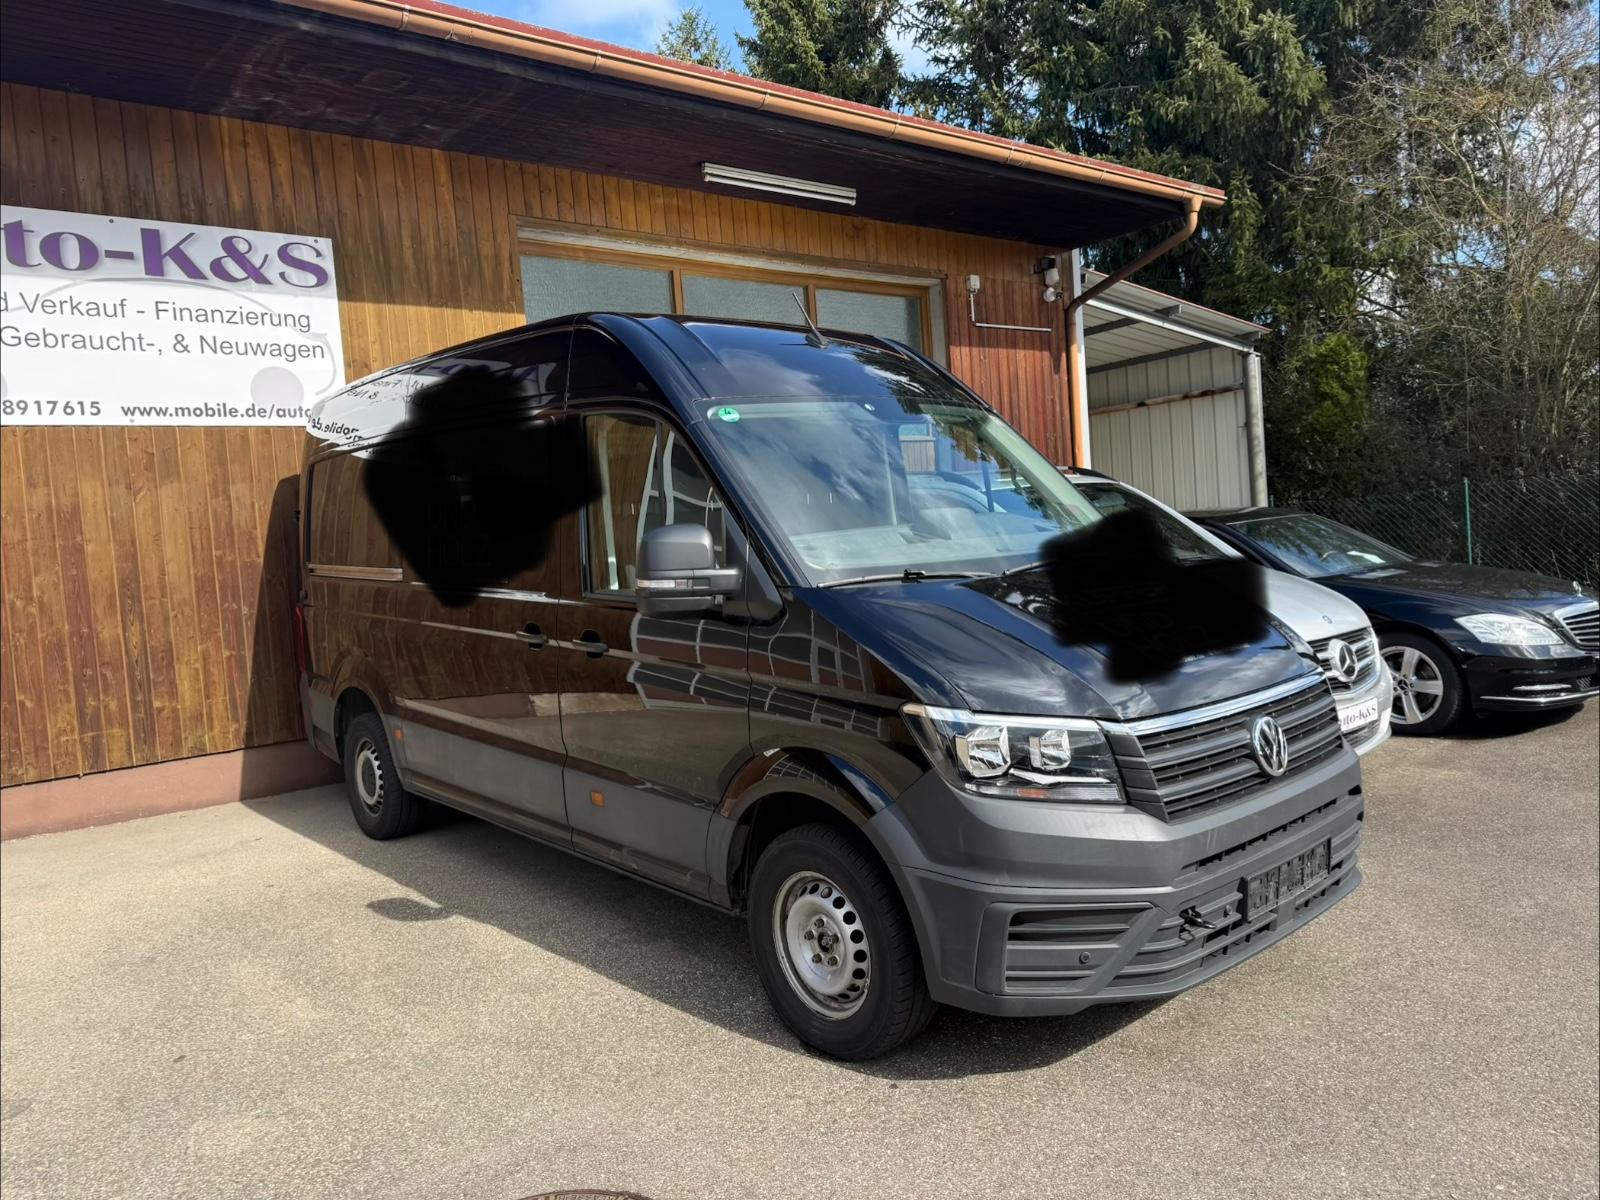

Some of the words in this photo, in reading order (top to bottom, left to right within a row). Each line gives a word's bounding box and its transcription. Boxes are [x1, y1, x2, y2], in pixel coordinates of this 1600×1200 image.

[19, 291, 127, 318] Verkauf
[155, 300, 312, 333] Finanzierung
[0, 325, 162, 356] Gebraucht-,
[172, 333, 191, 354] &
[199, 335, 325, 362] Neuwagen
[2, 399, 102, 416] 8917615
